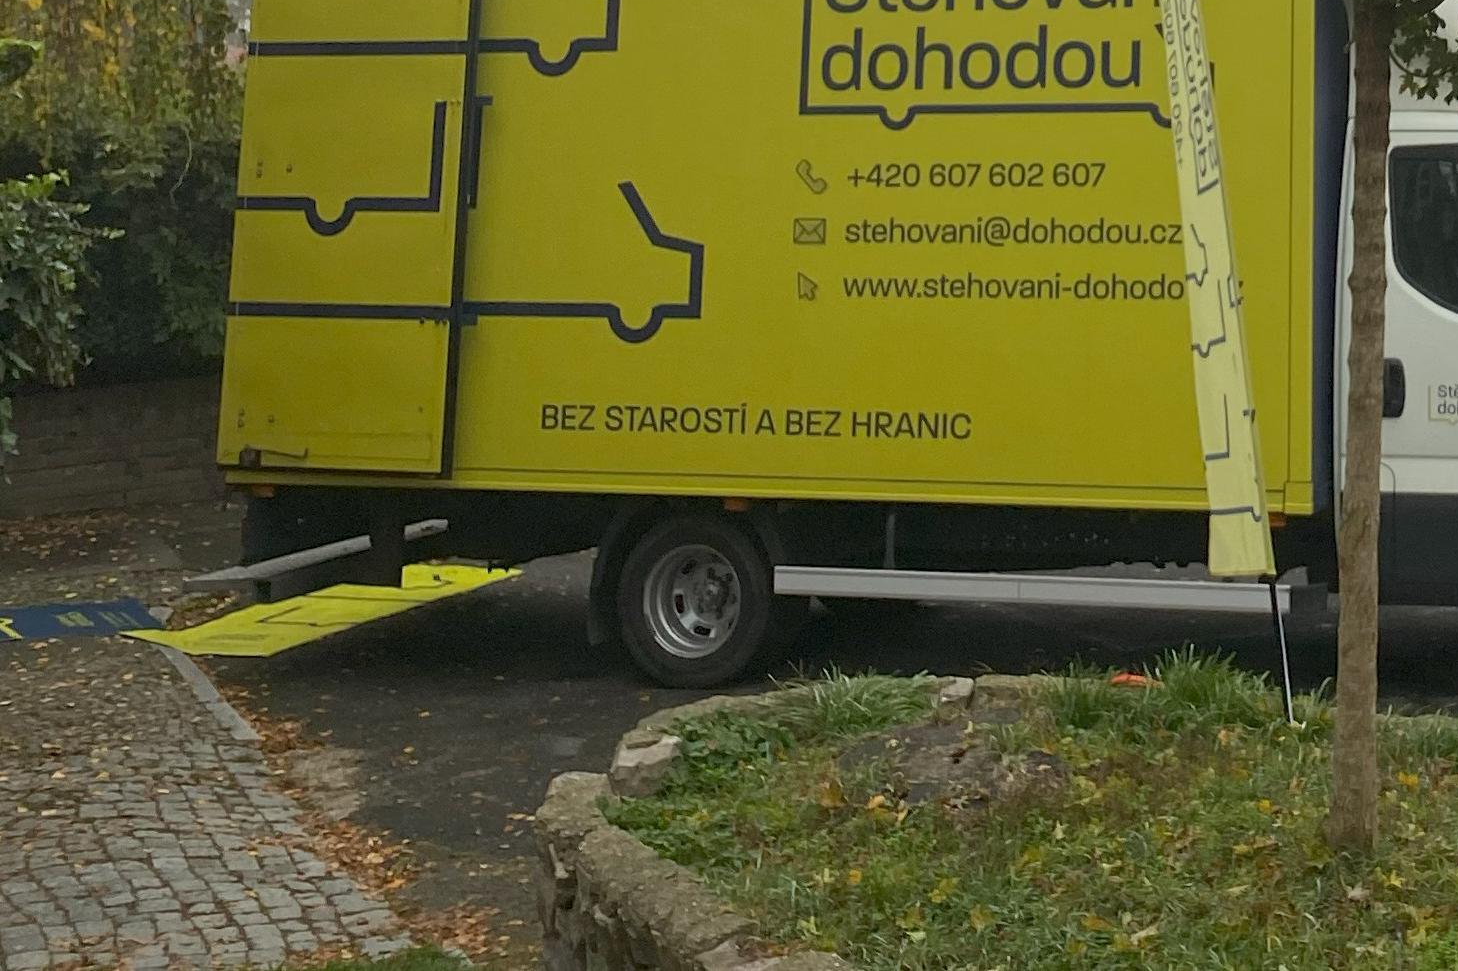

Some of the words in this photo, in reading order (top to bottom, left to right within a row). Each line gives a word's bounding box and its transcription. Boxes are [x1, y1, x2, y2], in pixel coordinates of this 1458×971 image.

[821, 23, 1141, 92] dohodou
[847, 163, 921, 188] +420
[929, 163, 982, 188] 607
[988, 162, 1044, 188] 602
[1052, 162, 1106, 188] 607
[844, 216, 1183, 247] stehovani@dohodou.cz
[842, 271, 1243, 302] www.stehovani-dohodo
[541, 404, 597, 431] BEZ
[604, 402, 748, 436] STAROSTÍ
[754, 408, 777, 436] A
[785, 409, 842, 437] BEZ
[851, 411, 973, 440] HRANIC
